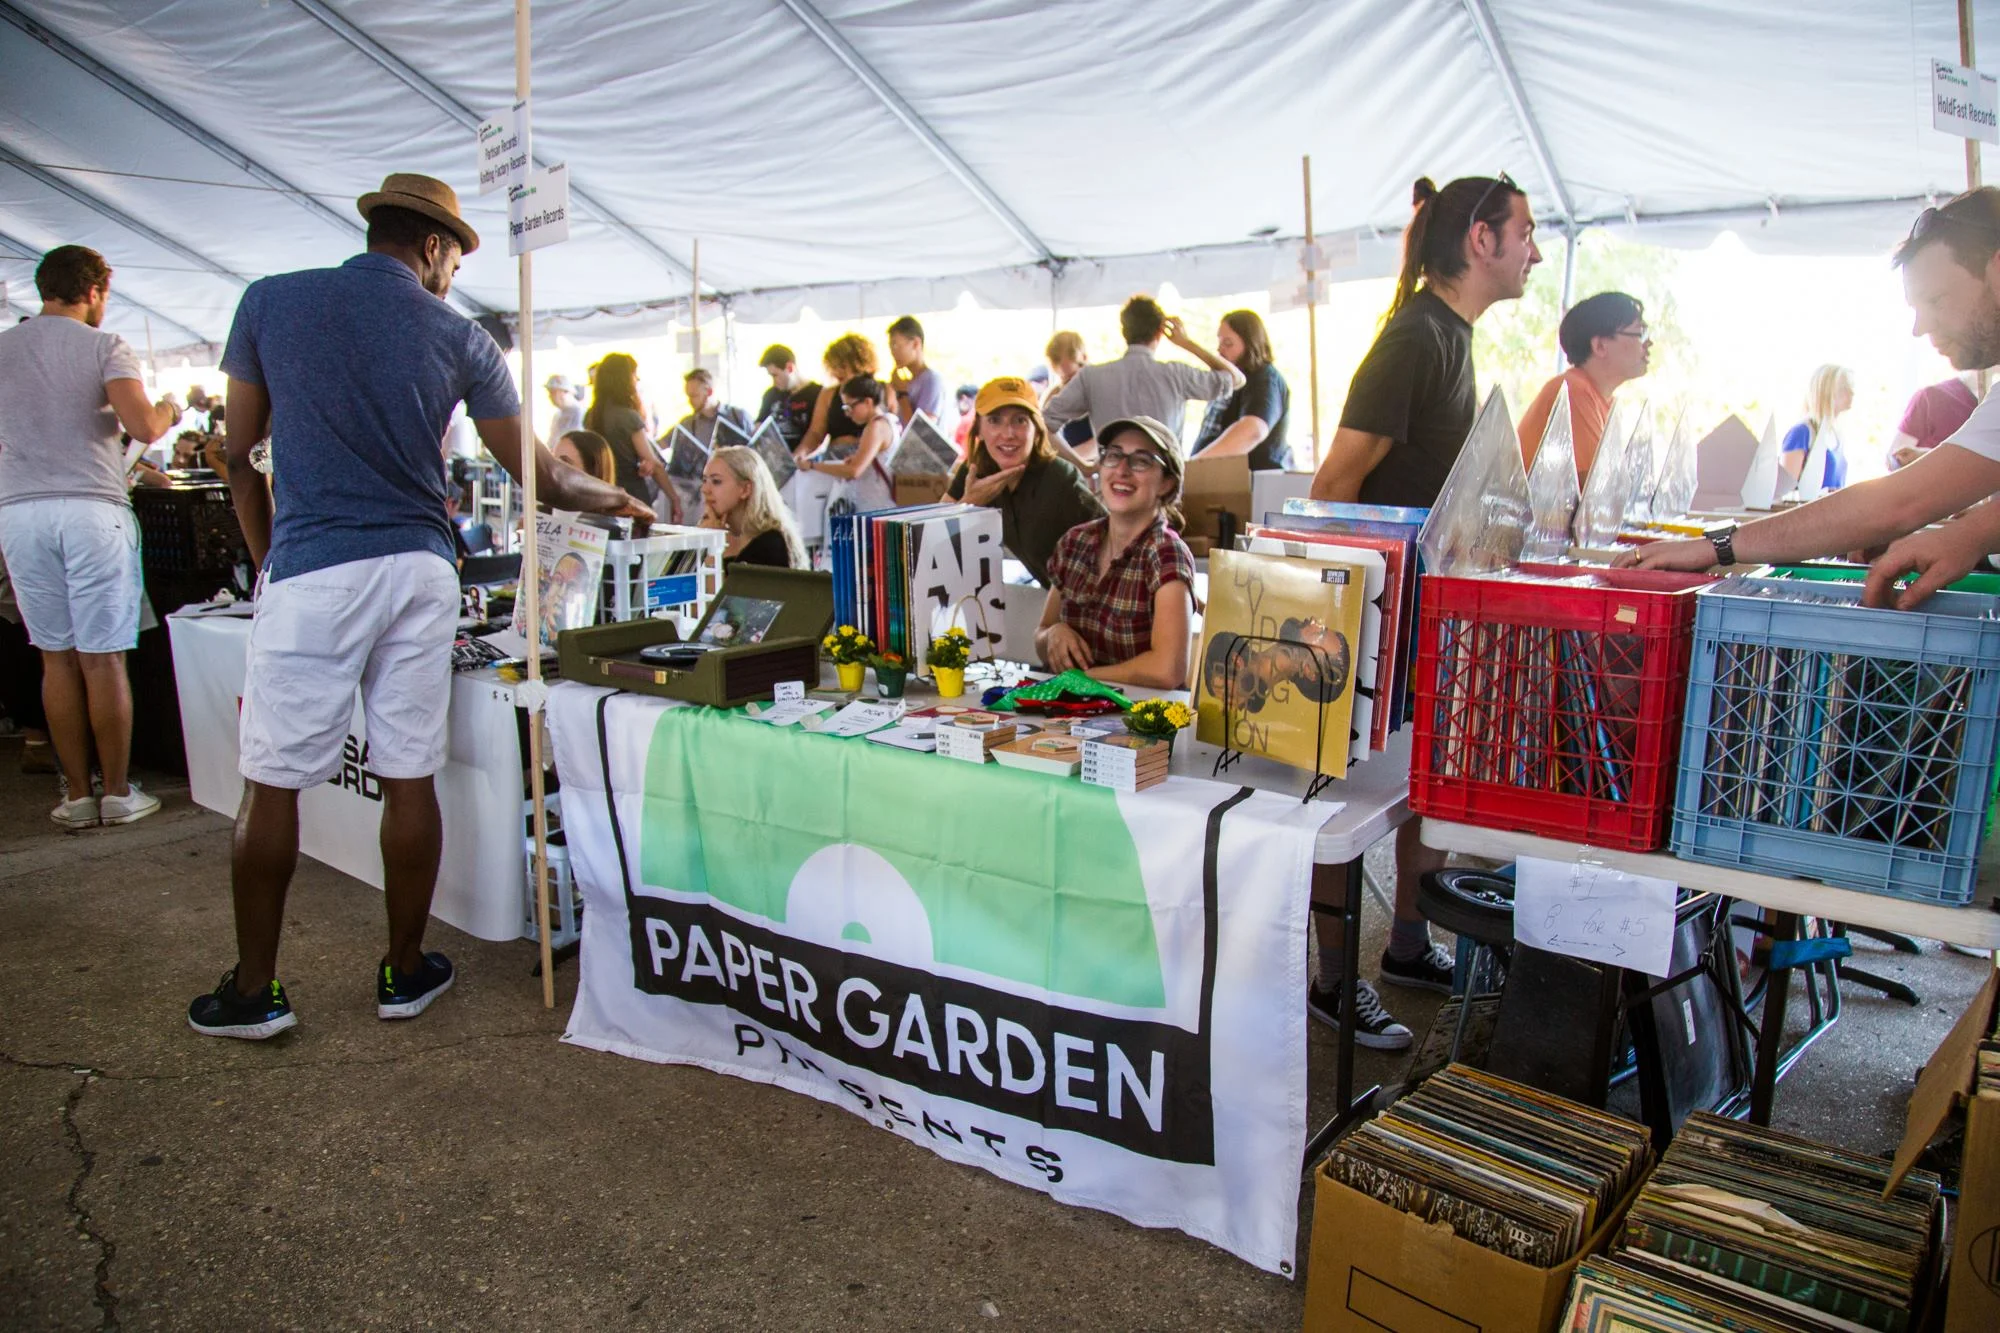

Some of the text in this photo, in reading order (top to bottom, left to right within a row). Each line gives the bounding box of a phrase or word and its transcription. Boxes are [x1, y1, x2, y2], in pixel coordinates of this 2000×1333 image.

[1937, 93, 1996, 127] HoldFast Records
[495, 160, 509, 177] Factory
[510, 152, 527, 170] Records
[509, 205, 565, 239] Paper Garden Records
[645, 917, 1165, 1132] PAPER GARDEN
